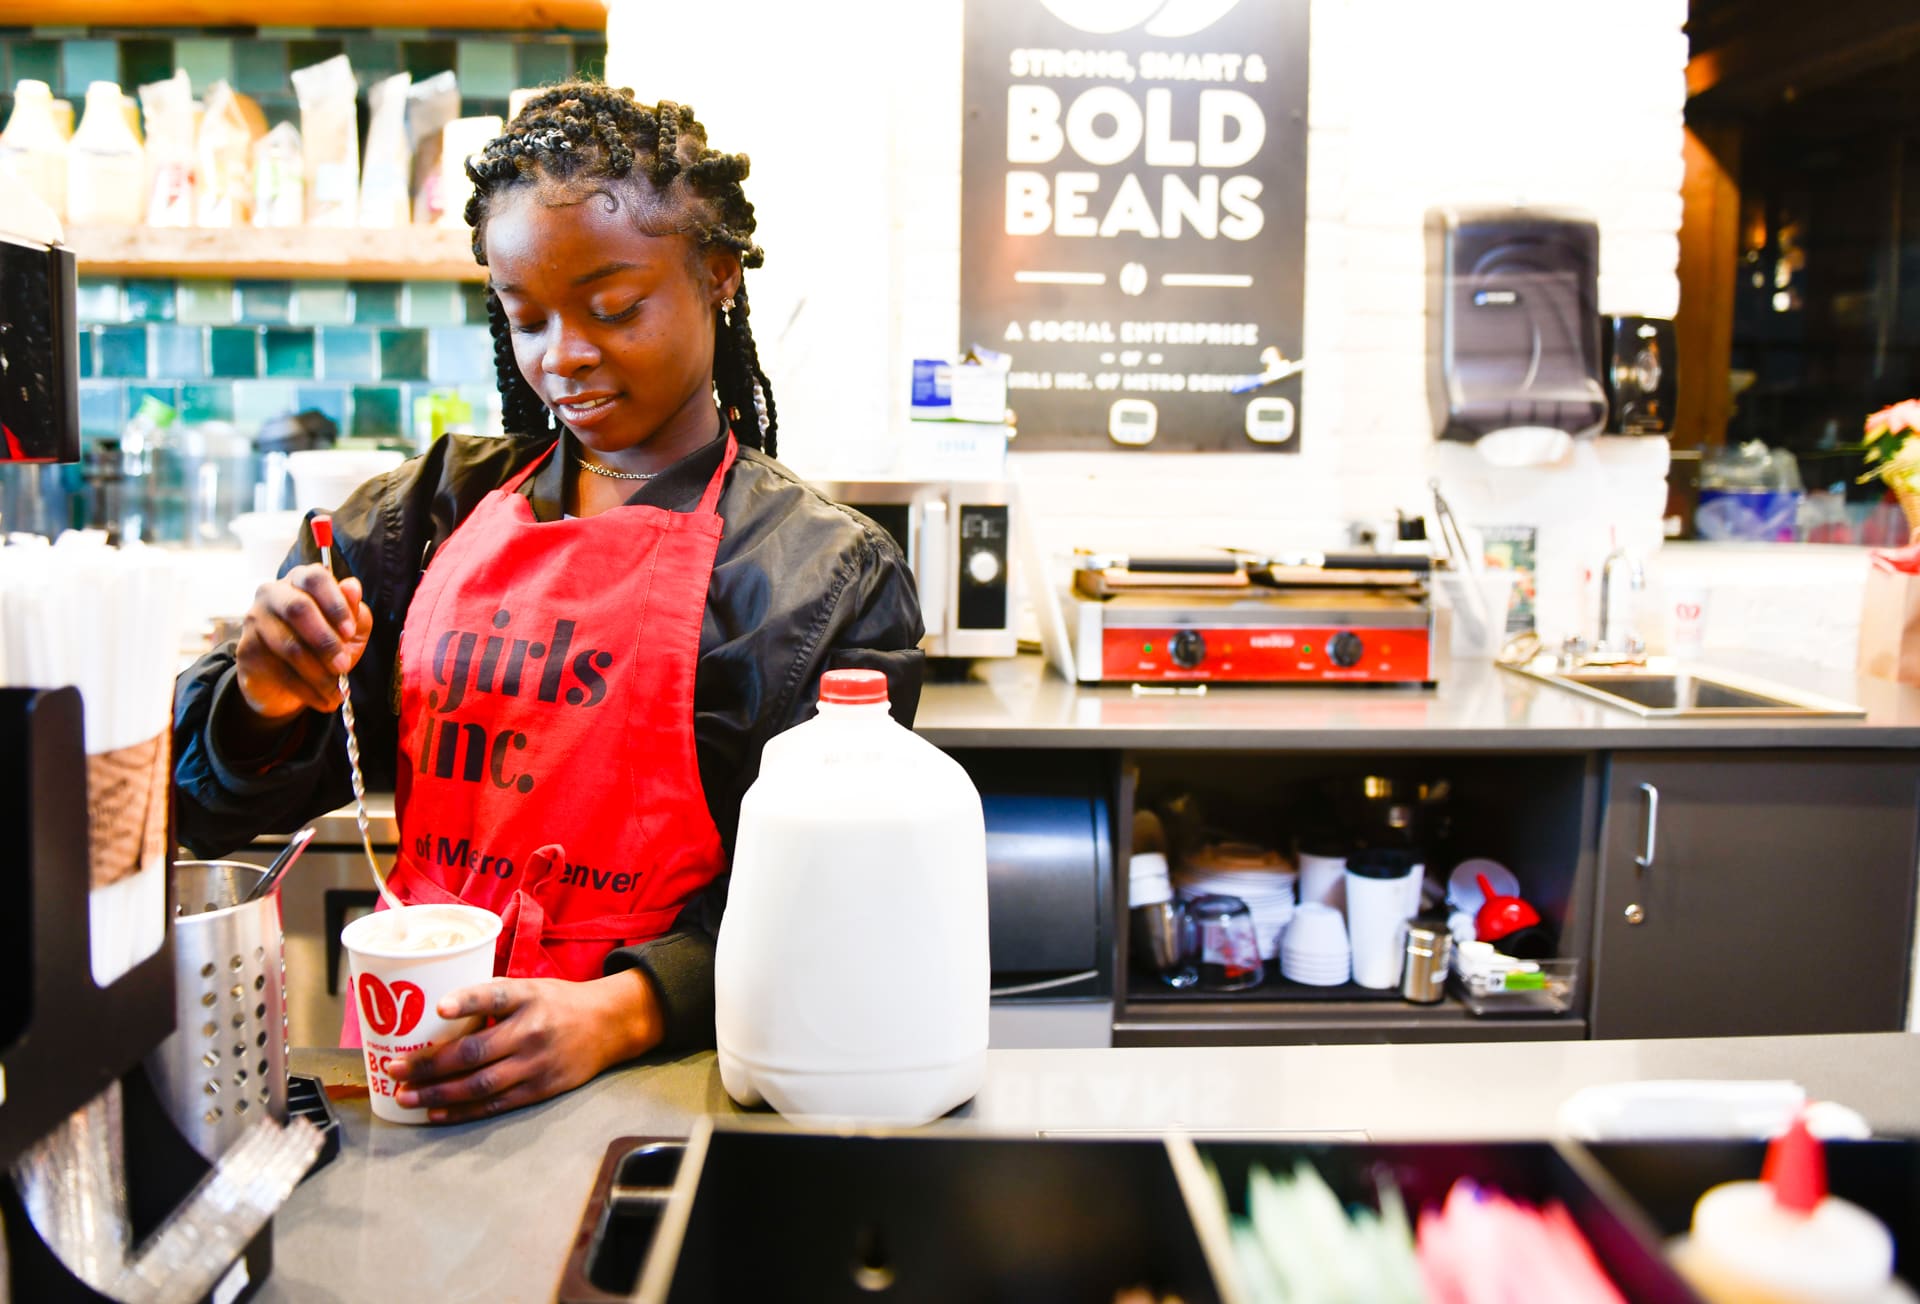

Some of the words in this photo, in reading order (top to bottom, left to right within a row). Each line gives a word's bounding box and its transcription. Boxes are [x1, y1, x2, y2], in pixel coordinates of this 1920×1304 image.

[1010, 49, 1135, 83] STRONG,
[1139, 51, 1242, 81] SMART
[1244, 54, 1267, 82] &
[1007, 85, 1266, 167] BOLD
[1005, 171, 1264, 240] BEANS
[1004, 321, 1024, 341] A
[1028, 320, 1116, 343] SOCIAL
[1119, 321, 1259, 345] ENTERPRISE
[1122, 373, 1186, 391] METRO
[429, 609, 613, 713] girls
[419, 717, 534, 793] inc.
[416, 833, 431, 860] of
[559, 862, 643, 893] enver
